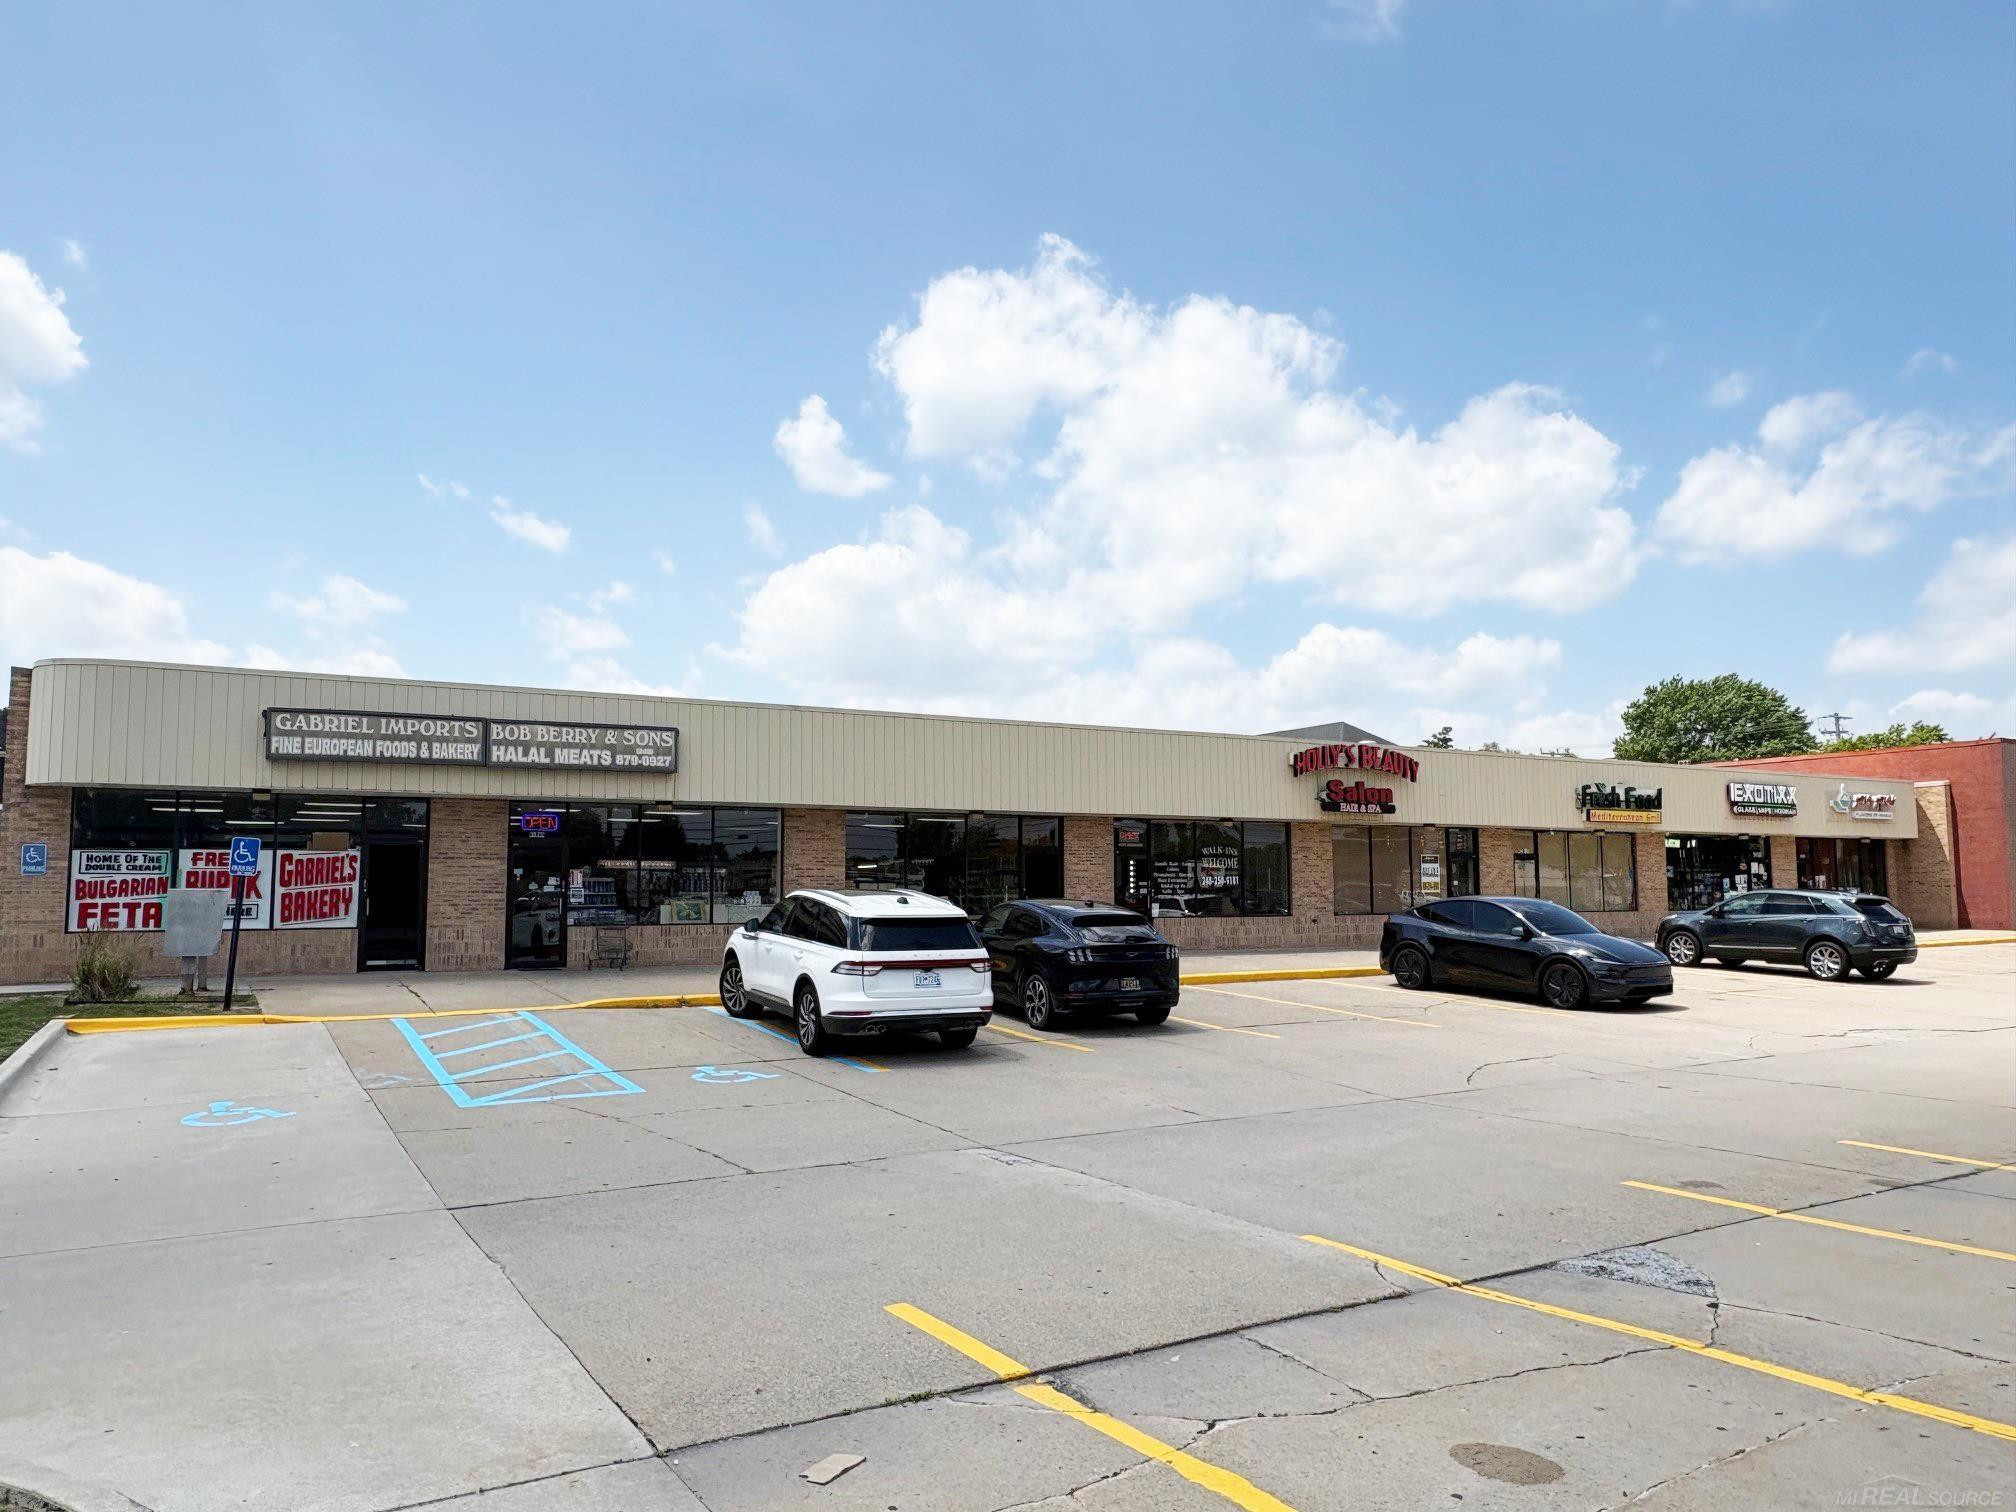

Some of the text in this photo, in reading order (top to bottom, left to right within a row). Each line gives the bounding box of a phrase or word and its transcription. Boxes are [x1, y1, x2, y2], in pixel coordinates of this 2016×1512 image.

[275, 713, 478, 738] GABRIEL IMPORTS
[490, 722, 673, 747] BOB BERRY & SONS
[271, 736, 481, 760] FINE EUROPEAN FOODS & BAKERY
[491, 745, 551, 764] HALAL
[554, 747, 612, 766] MEATS
[1293, 744, 1419, 782] HOLLY'S BEAUTY
[1326, 779, 1393, 803] Salon
[1624, 786, 1662, 809] Food
[1734, 783, 1797, 804] EXOTIXX
[1340, 802, 1382, 813] HAIR & SPA
[86, 854, 162, 863] HOME OF THE
[279, 853, 358, 887] GABRIEL'S
[1202, 857, 1239, 868] WELCOME
[75, 877, 169, 900] BULGARIAN
[77, 902, 163, 928] FETA
[280, 887, 353, 923] BAKERY
